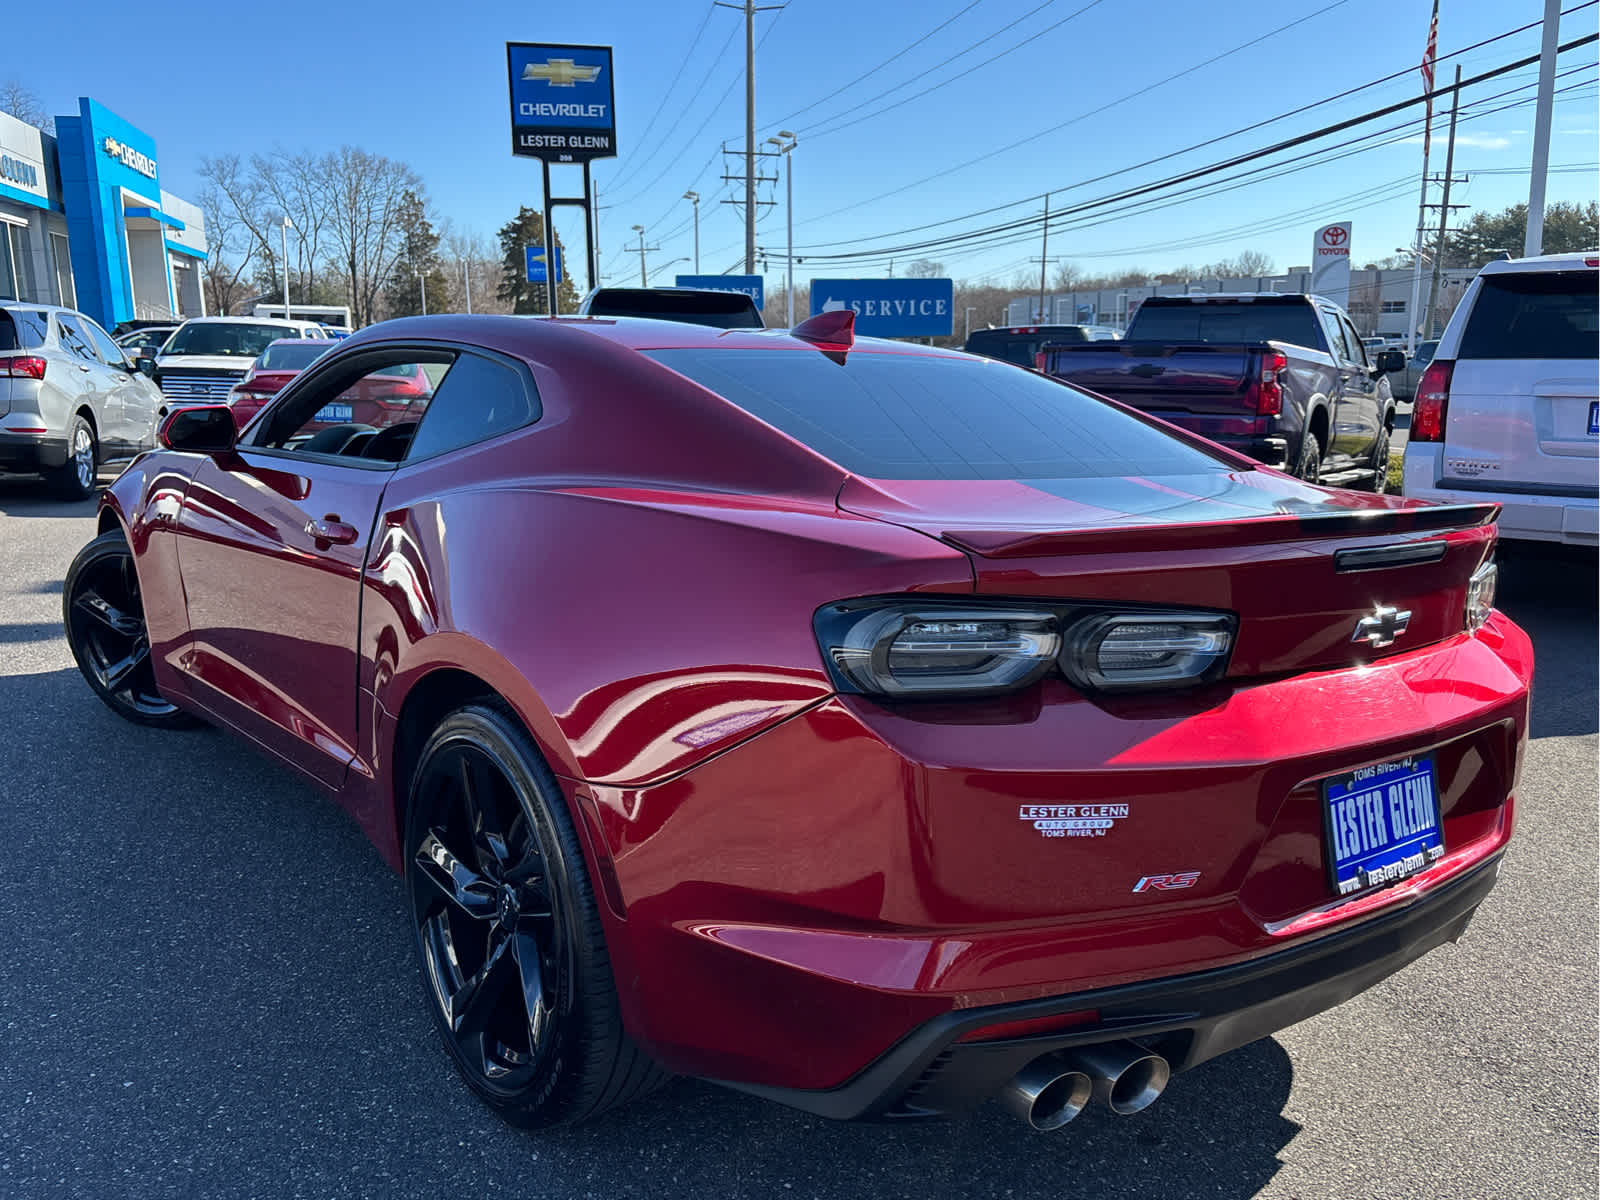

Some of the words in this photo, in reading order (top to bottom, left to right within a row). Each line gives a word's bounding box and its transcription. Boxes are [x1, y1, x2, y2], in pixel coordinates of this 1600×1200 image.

[519, 103, 606, 117] CHEVROLET
[520, 135, 566, 147] LESTER
[569, 136, 609, 149] GLENN
[1317, 247, 1350, 256] TOYOTA
[850, 298, 947, 316] SERVICE
[1353, 766, 1376, 782] TOMS
[1019, 807, 1076, 818] LESTER
[1080, 806, 1128, 817] GLENN
[1330, 790, 1388, 861] LESTER
[1388, 775, 1435, 841] GLENN
[1073, 820, 1111, 828] GROUP
[1132, 871, 1202, 893] RS
